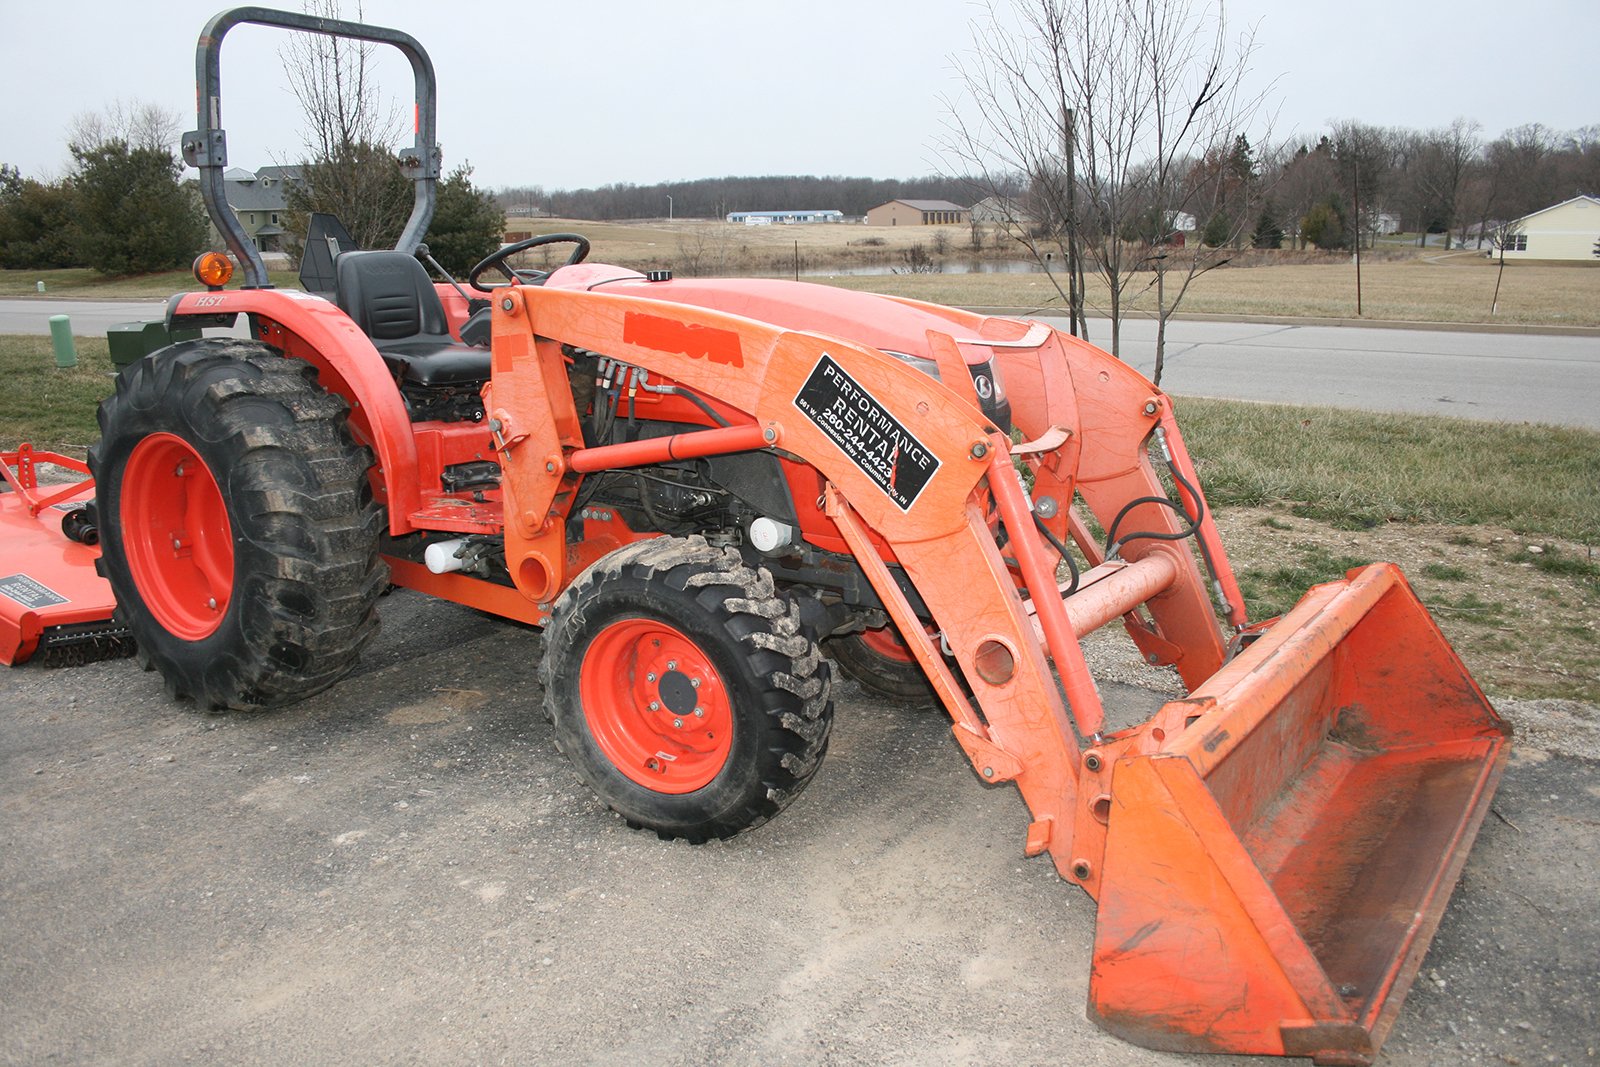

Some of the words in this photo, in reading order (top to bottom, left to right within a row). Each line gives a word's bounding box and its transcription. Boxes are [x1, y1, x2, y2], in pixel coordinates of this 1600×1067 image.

[193, 295, 225, 307] HST
[822, 408, 893, 478] 260-244-4423
[823, 364, 931, 470] PERFORMANCE
[832, 396, 897, 466] RENTAL
[817, 415, 846, 445] Connexion
[845, 442, 858, 457] Way
[861, 458, 887, 486] Columbia
[886, 483, 899, 499] Cty,
[899, 495, 908, 505] IN
